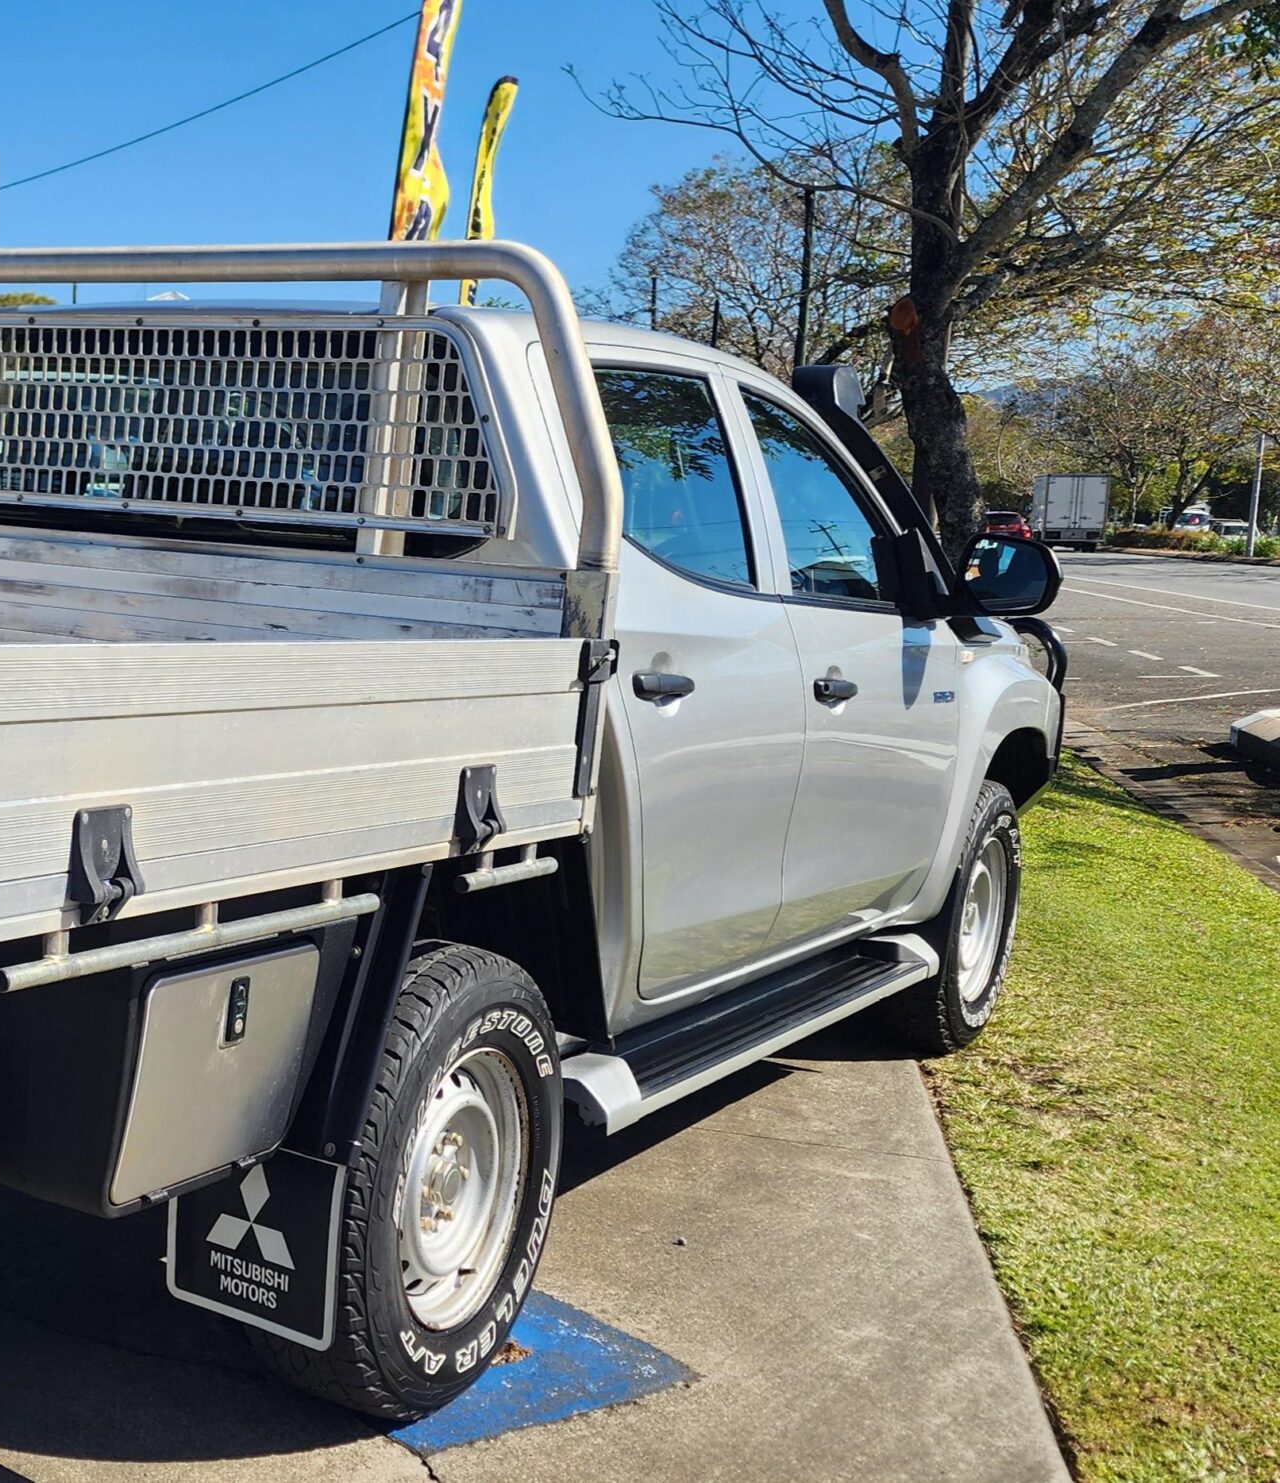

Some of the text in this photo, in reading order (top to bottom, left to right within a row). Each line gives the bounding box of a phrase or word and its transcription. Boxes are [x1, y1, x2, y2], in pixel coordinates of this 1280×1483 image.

[209, 1249, 290, 1293] MITSUBISHI
[219, 1274, 278, 1310] MOTORS
[455, 1168, 553, 1373] DUELER
